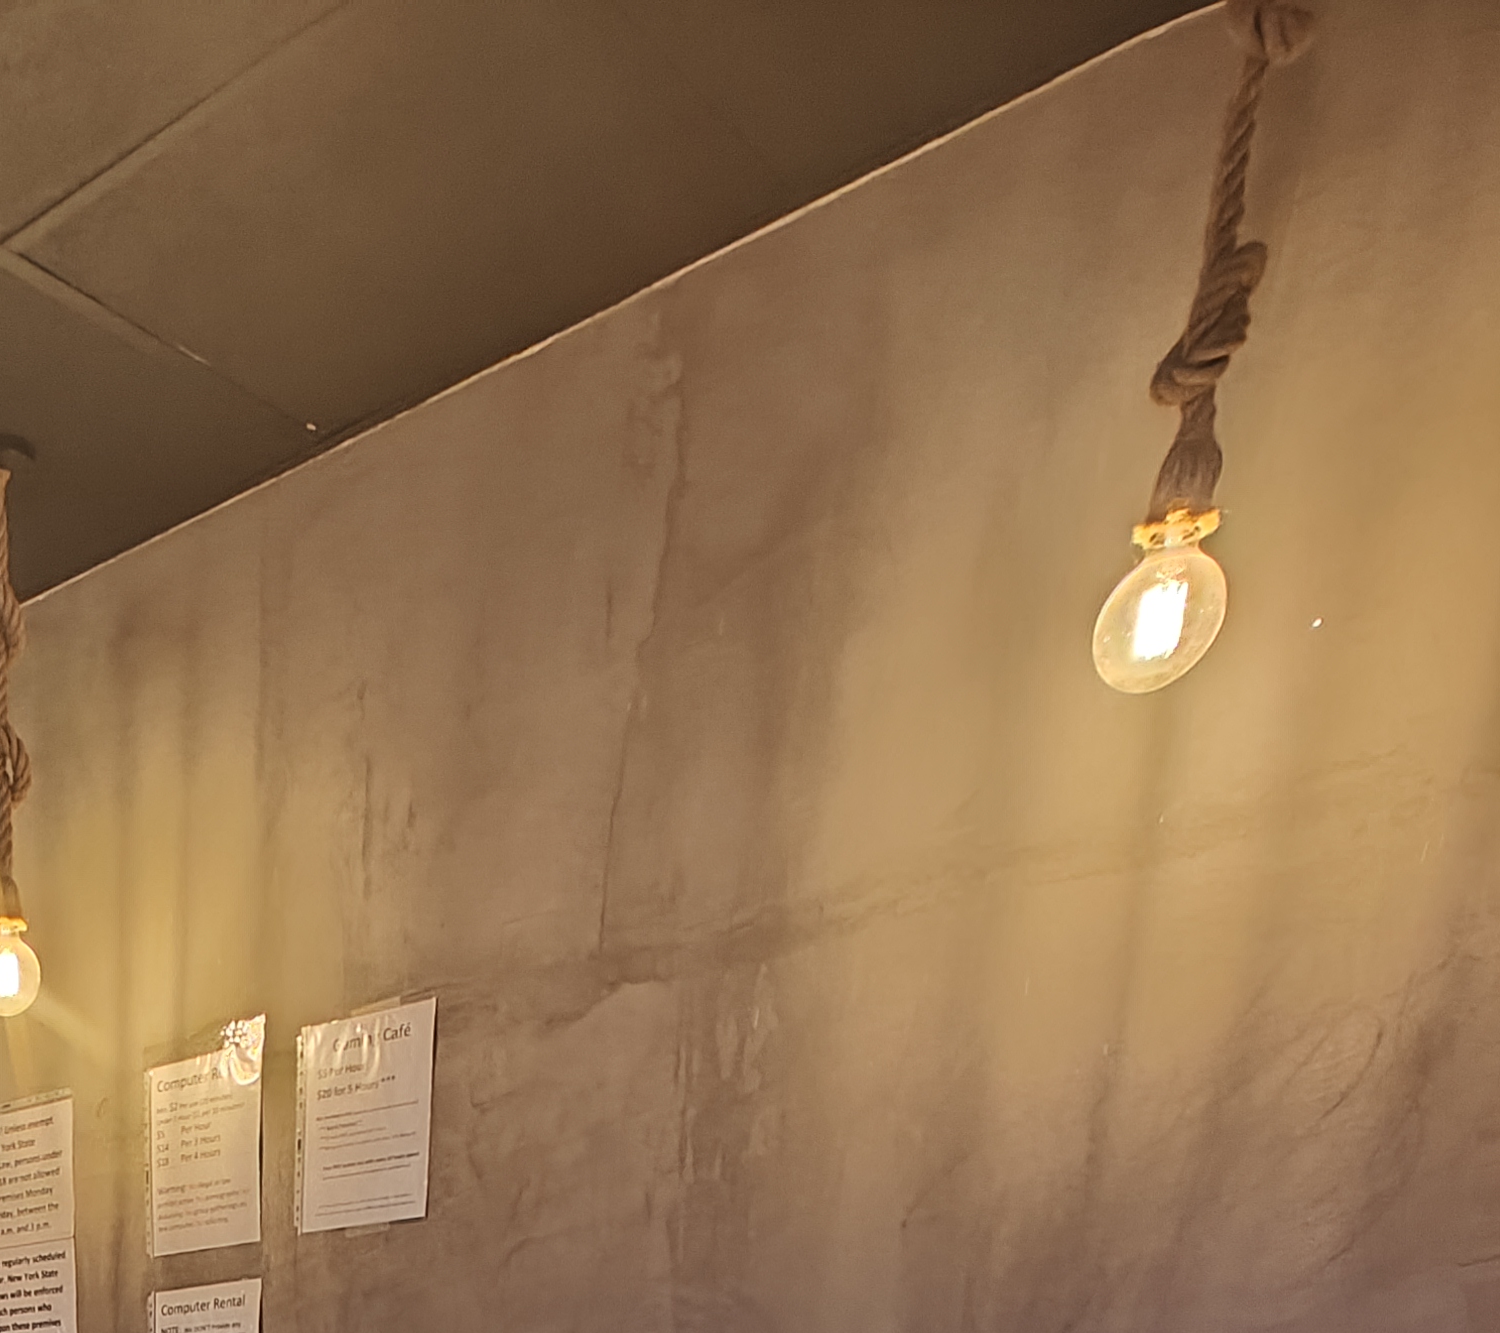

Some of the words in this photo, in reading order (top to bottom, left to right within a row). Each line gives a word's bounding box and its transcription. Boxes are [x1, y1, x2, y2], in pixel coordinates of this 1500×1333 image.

[383, 1022, 412, 1042] Café
[25, 1186, 53, 1198] Monday
[2, 1256, 30, 1268] regularly
[32, 1251, 66, 1262] scheduled
[7, 1274, 22, 1283] New
[24, 1271, 40, 1281] York
[41, 1269, 58, 1279] State
[10, 1289, 22, 1299] will
[23, 1288, 32, 1297] be
[33, 1284, 64, 1296] enforced
[9, 1305, 36, 1317] persons
[37, 1302, 52, 1312] who
[161, 1301, 210, 1317] Computer
[213, 1294, 246, 1310] Rental
[11, 1322, 30, 1332] these
[31, 1319, 61, 1330] premises
